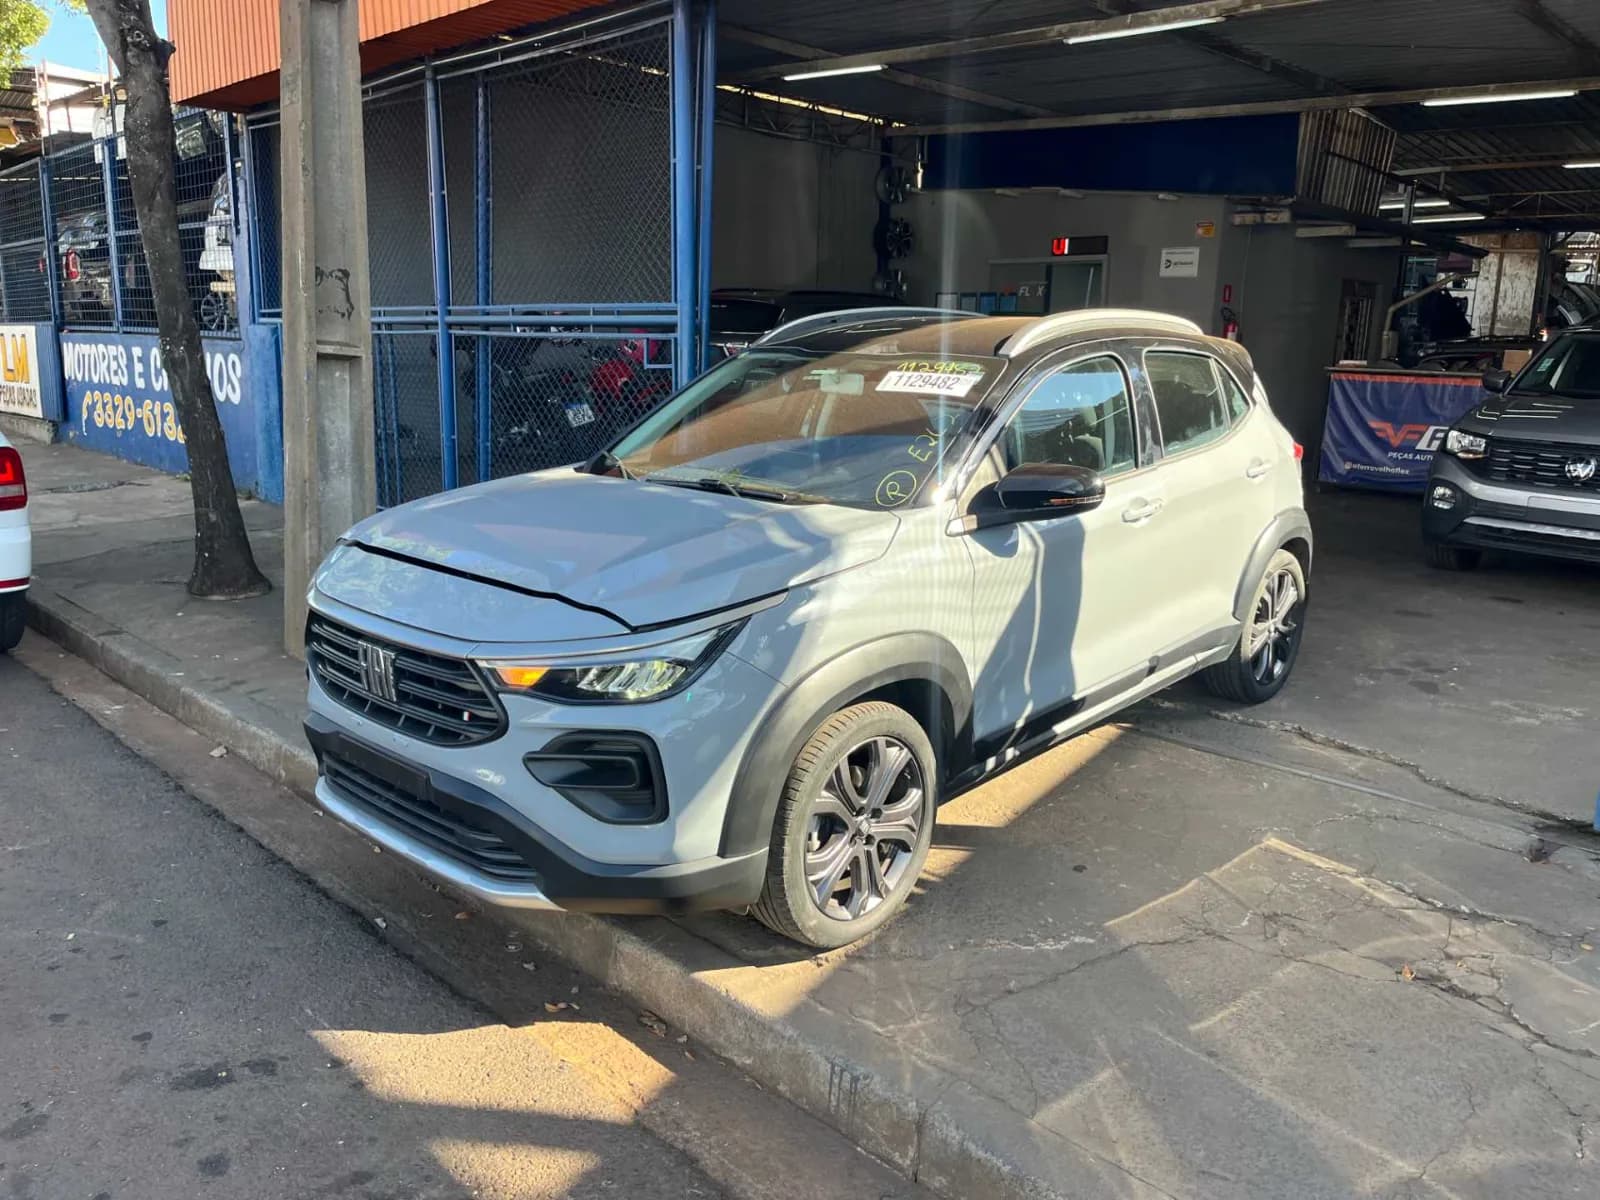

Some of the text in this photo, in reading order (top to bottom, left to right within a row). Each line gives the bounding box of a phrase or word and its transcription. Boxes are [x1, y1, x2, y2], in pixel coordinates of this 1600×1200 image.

[63, 342, 129, 386] MOTORES
[131, 346, 146, 389] E
[894, 373, 960, 391] 1129482
